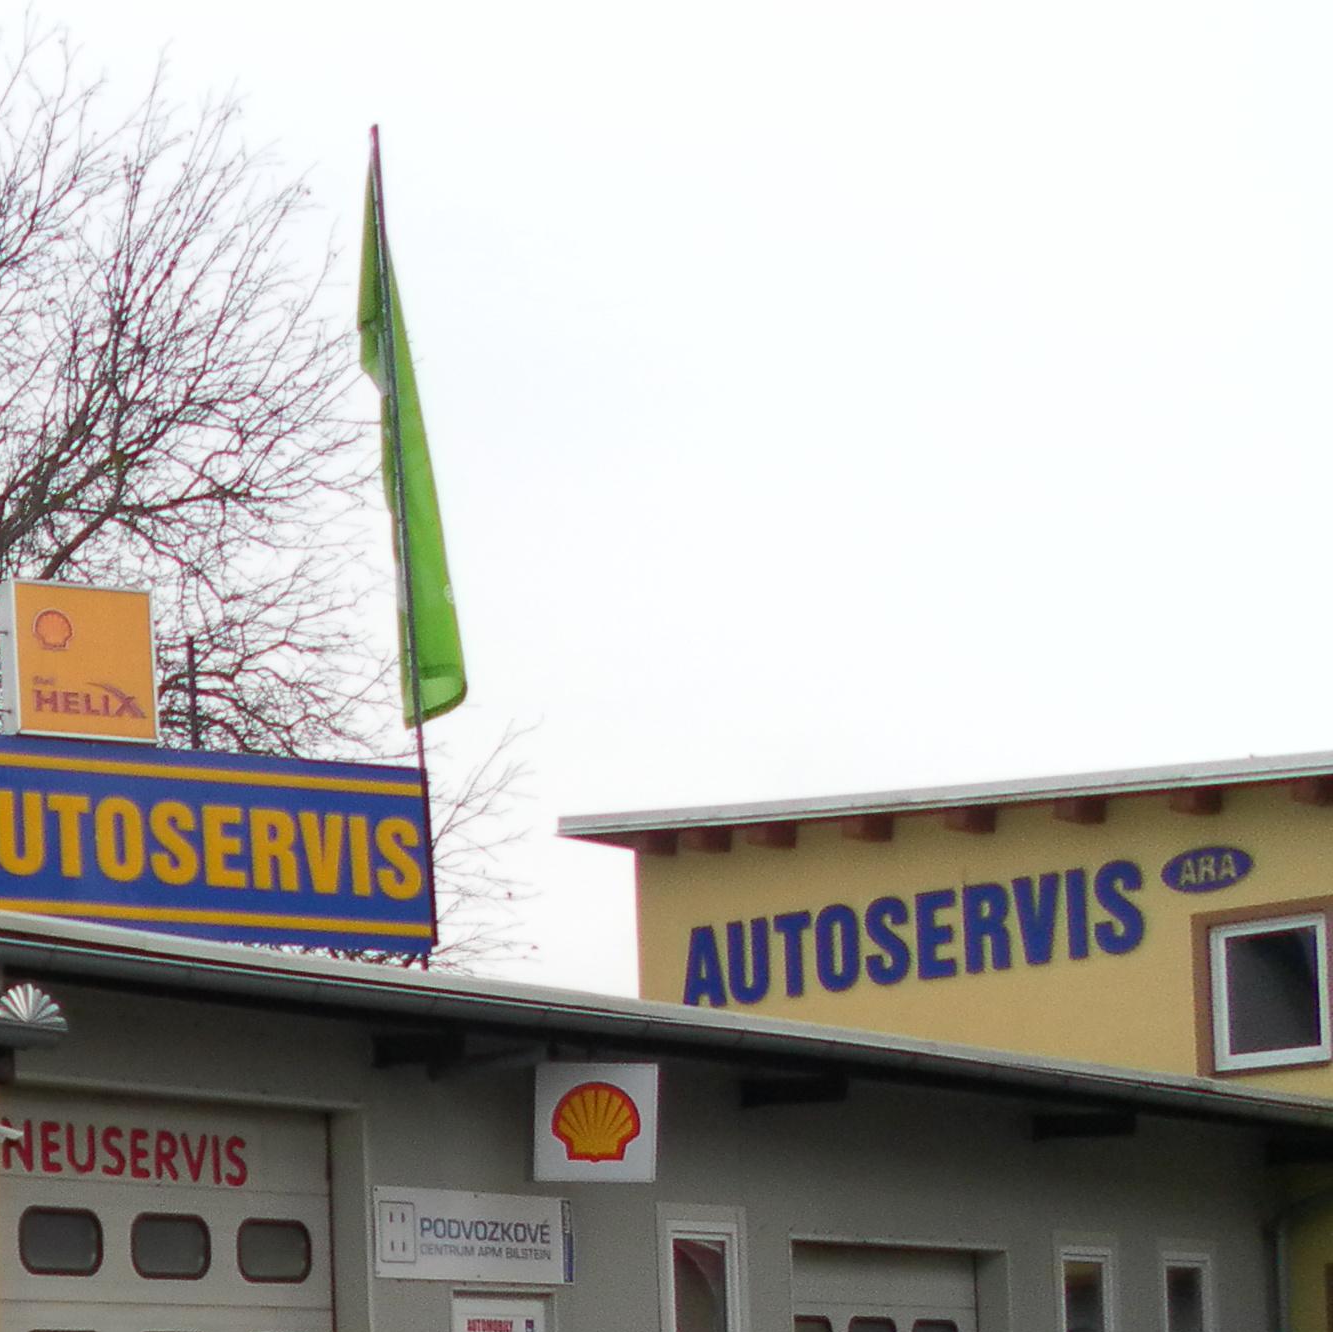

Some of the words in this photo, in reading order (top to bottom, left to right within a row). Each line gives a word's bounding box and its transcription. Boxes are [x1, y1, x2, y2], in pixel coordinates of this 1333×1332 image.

[34, 686, 146, 719] HELIX
[683, 860, 1146, 1008] AUTOSERVIS
[1179, 849, 1236, 887] ARA
[419, 1217, 551, 1245] PODVOZKOVÉ
